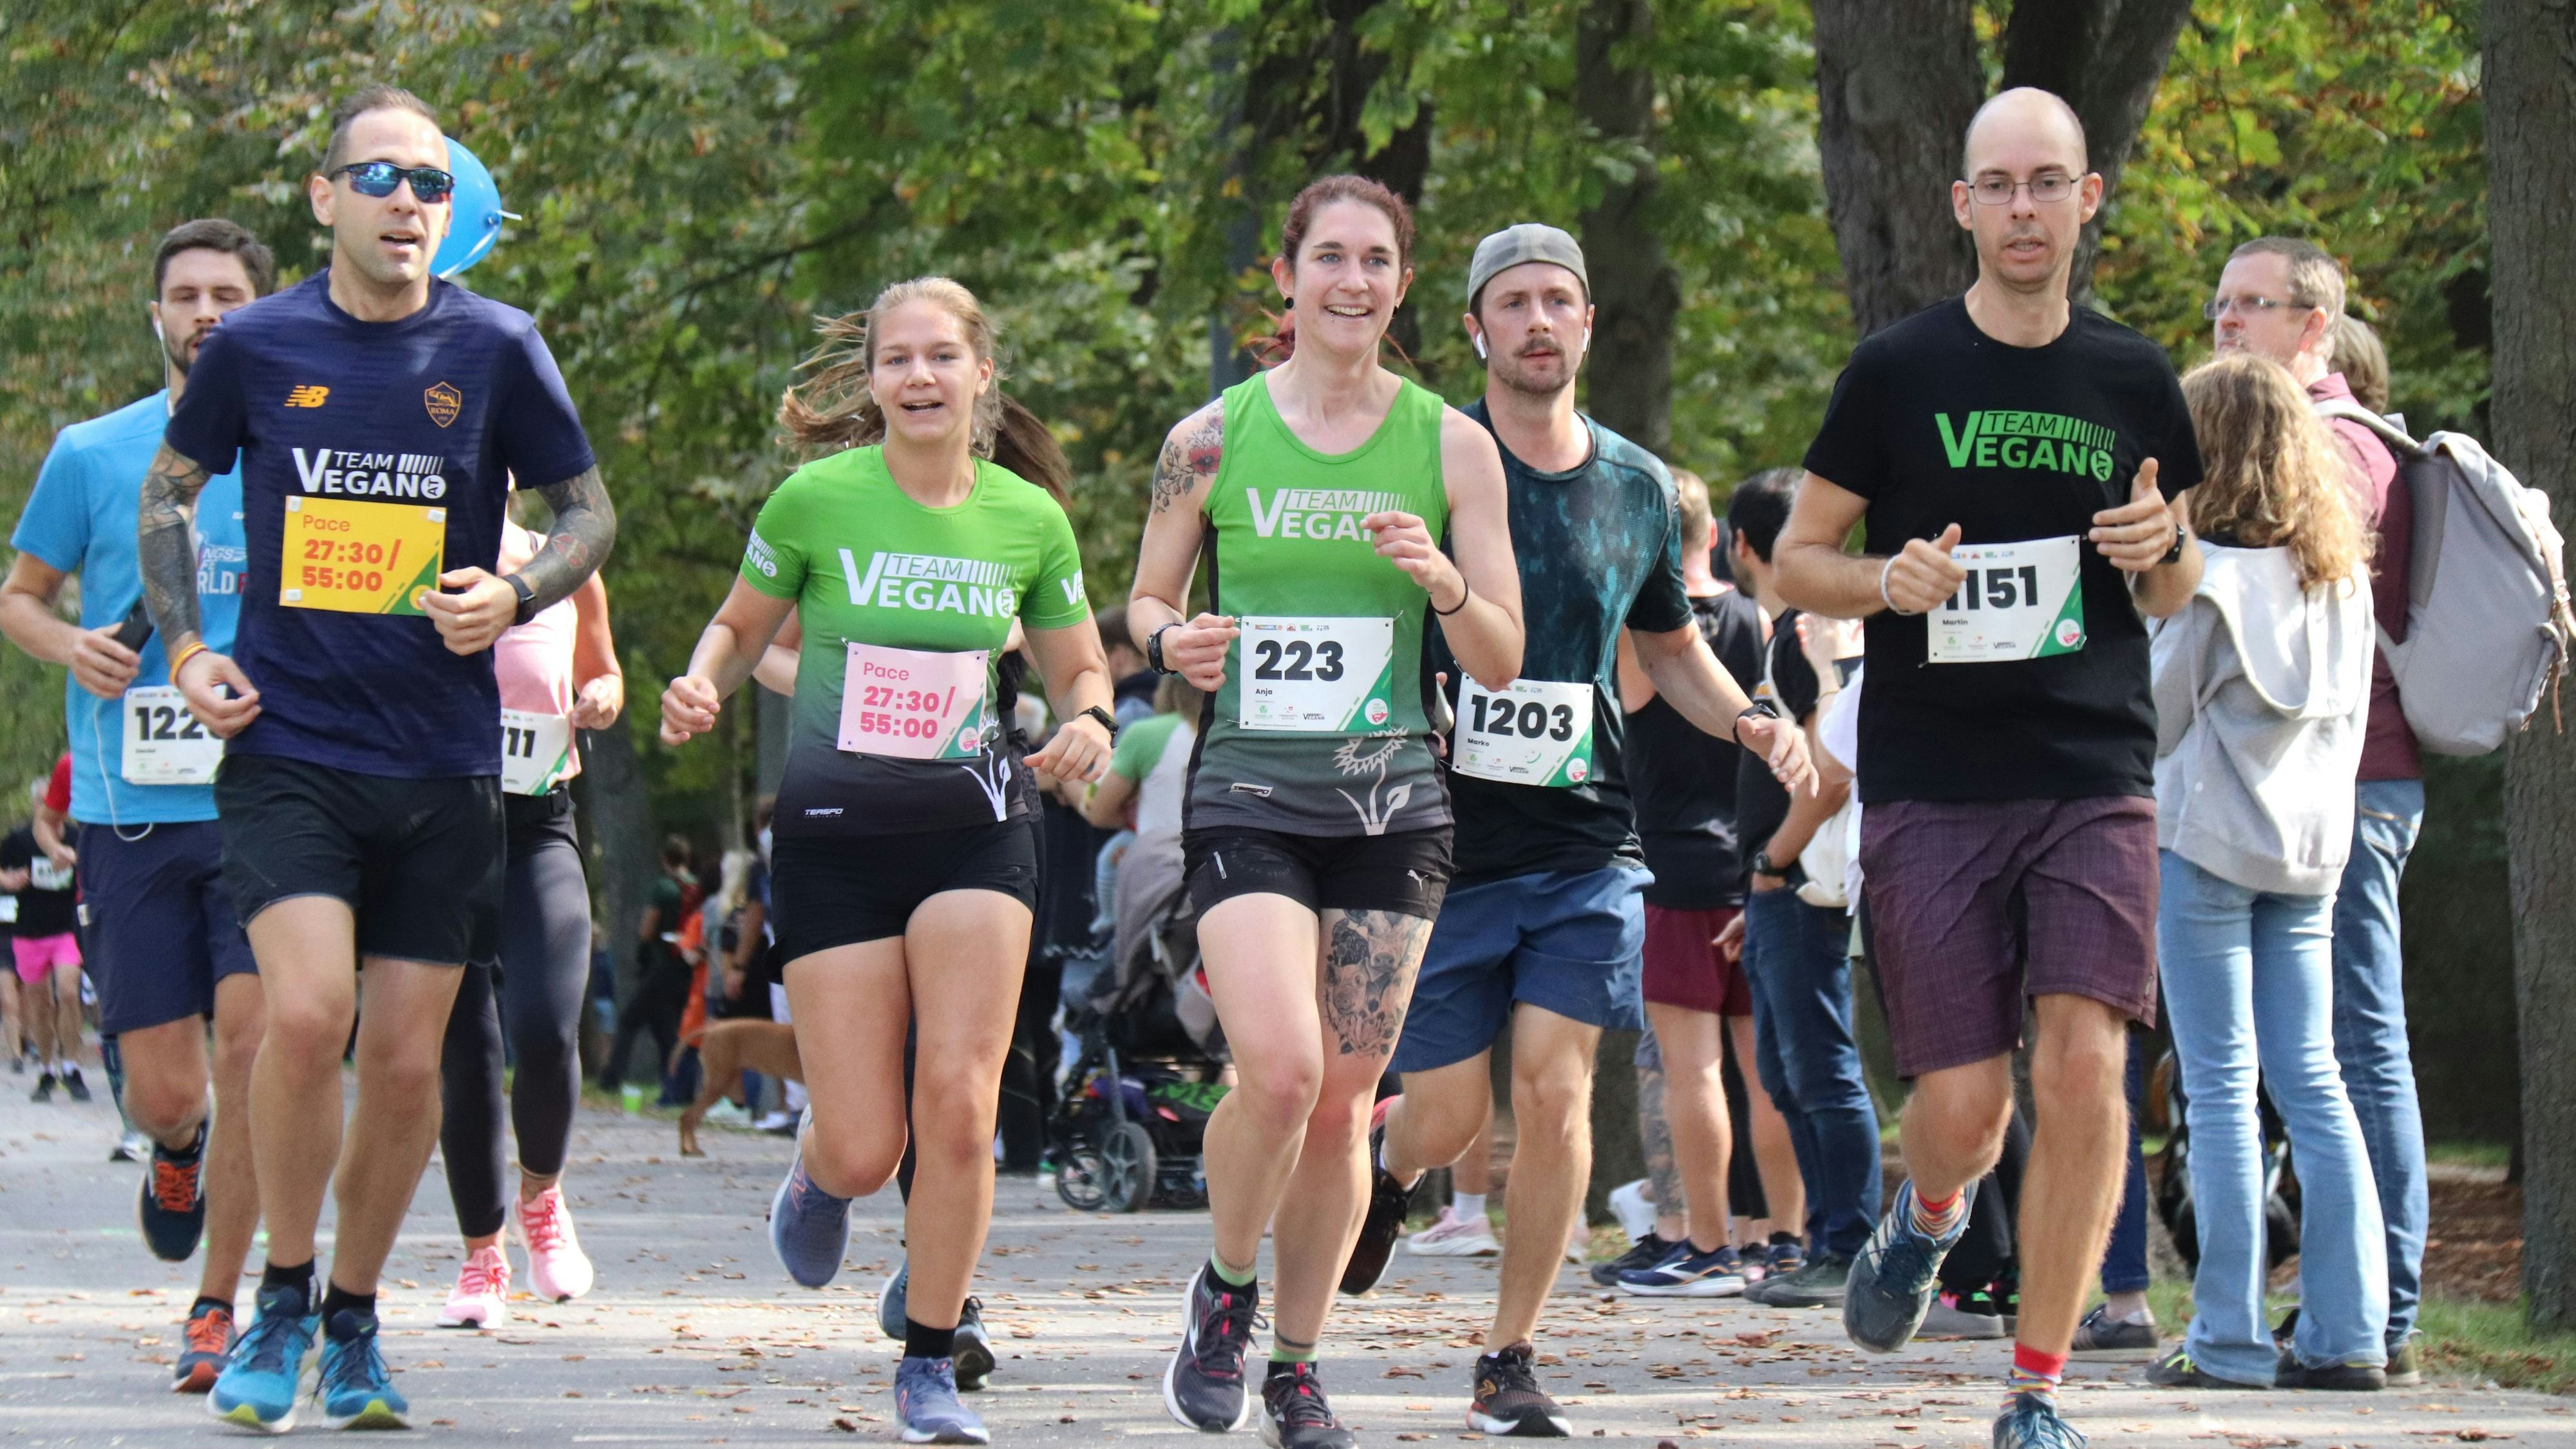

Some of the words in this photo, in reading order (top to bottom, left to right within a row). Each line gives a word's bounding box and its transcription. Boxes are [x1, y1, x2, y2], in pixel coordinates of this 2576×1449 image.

[431, 407, 455, 415] ROMA
[1987, 412, 2058, 435] TEAM
[1935, 411, 2088, 476] VEGAN
[292, 448, 419, 498] VEGAN
[334, 451, 394, 470] TEAM
[1293, 490, 1359, 510] TEAM
[303, 515, 350, 532] Pace
[301, 565, 383, 592] 55:00
[892, 554, 964, 580] TEAM
[196, 570, 235, 594] RLD
[838, 548, 994, 618] VEGAN
[863, 662, 910, 681] Pace
[1255, 639, 1344, 682] 223
[1255, 688, 1273, 696] Anja
[135, 706, 223, 741] 122
[860, 711, 938, 739] 55:00
[1471, 694, 1574, 742] 1203
[501, 726, 536, 759] 11
[1468, 737, 1490, 746] Marko
